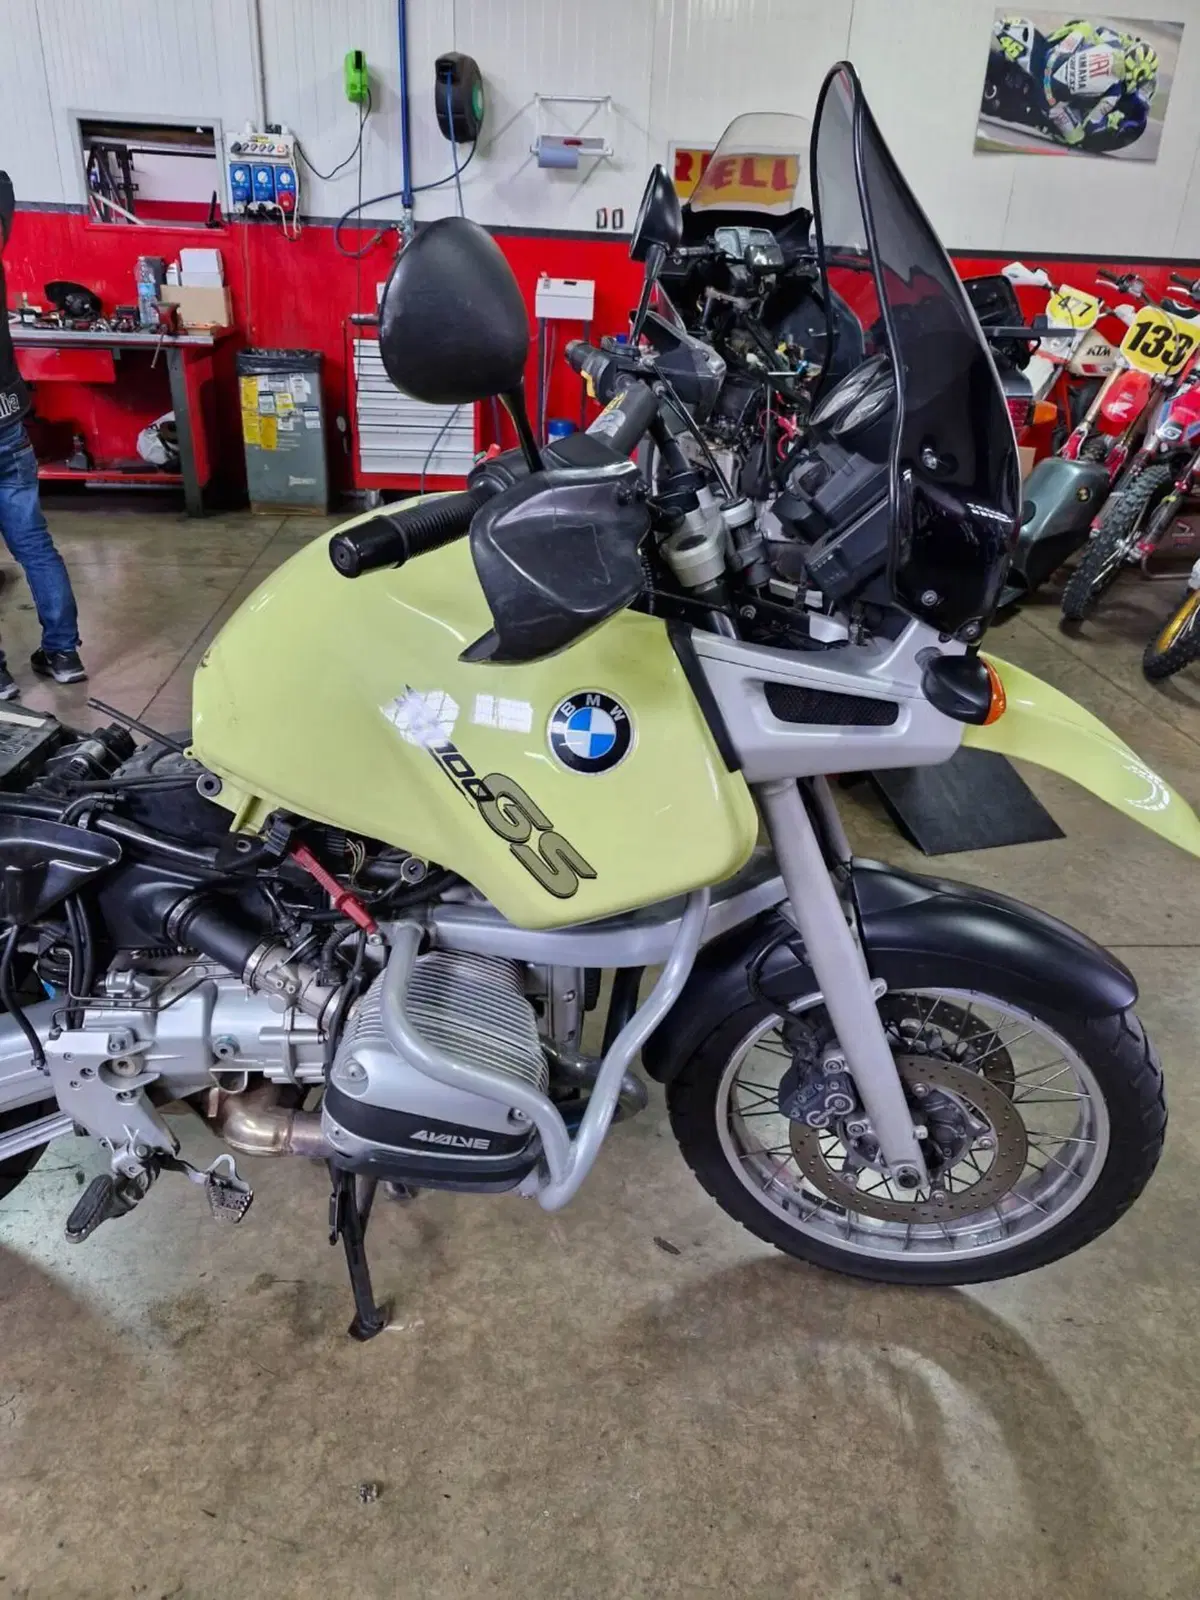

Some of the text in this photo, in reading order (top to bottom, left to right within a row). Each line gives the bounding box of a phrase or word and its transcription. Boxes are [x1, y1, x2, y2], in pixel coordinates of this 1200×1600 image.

[1085, 344, 1112, 357] KTM
[1127, 321, 1194, 366] 133
[559, 694, 626, 721] BMW
